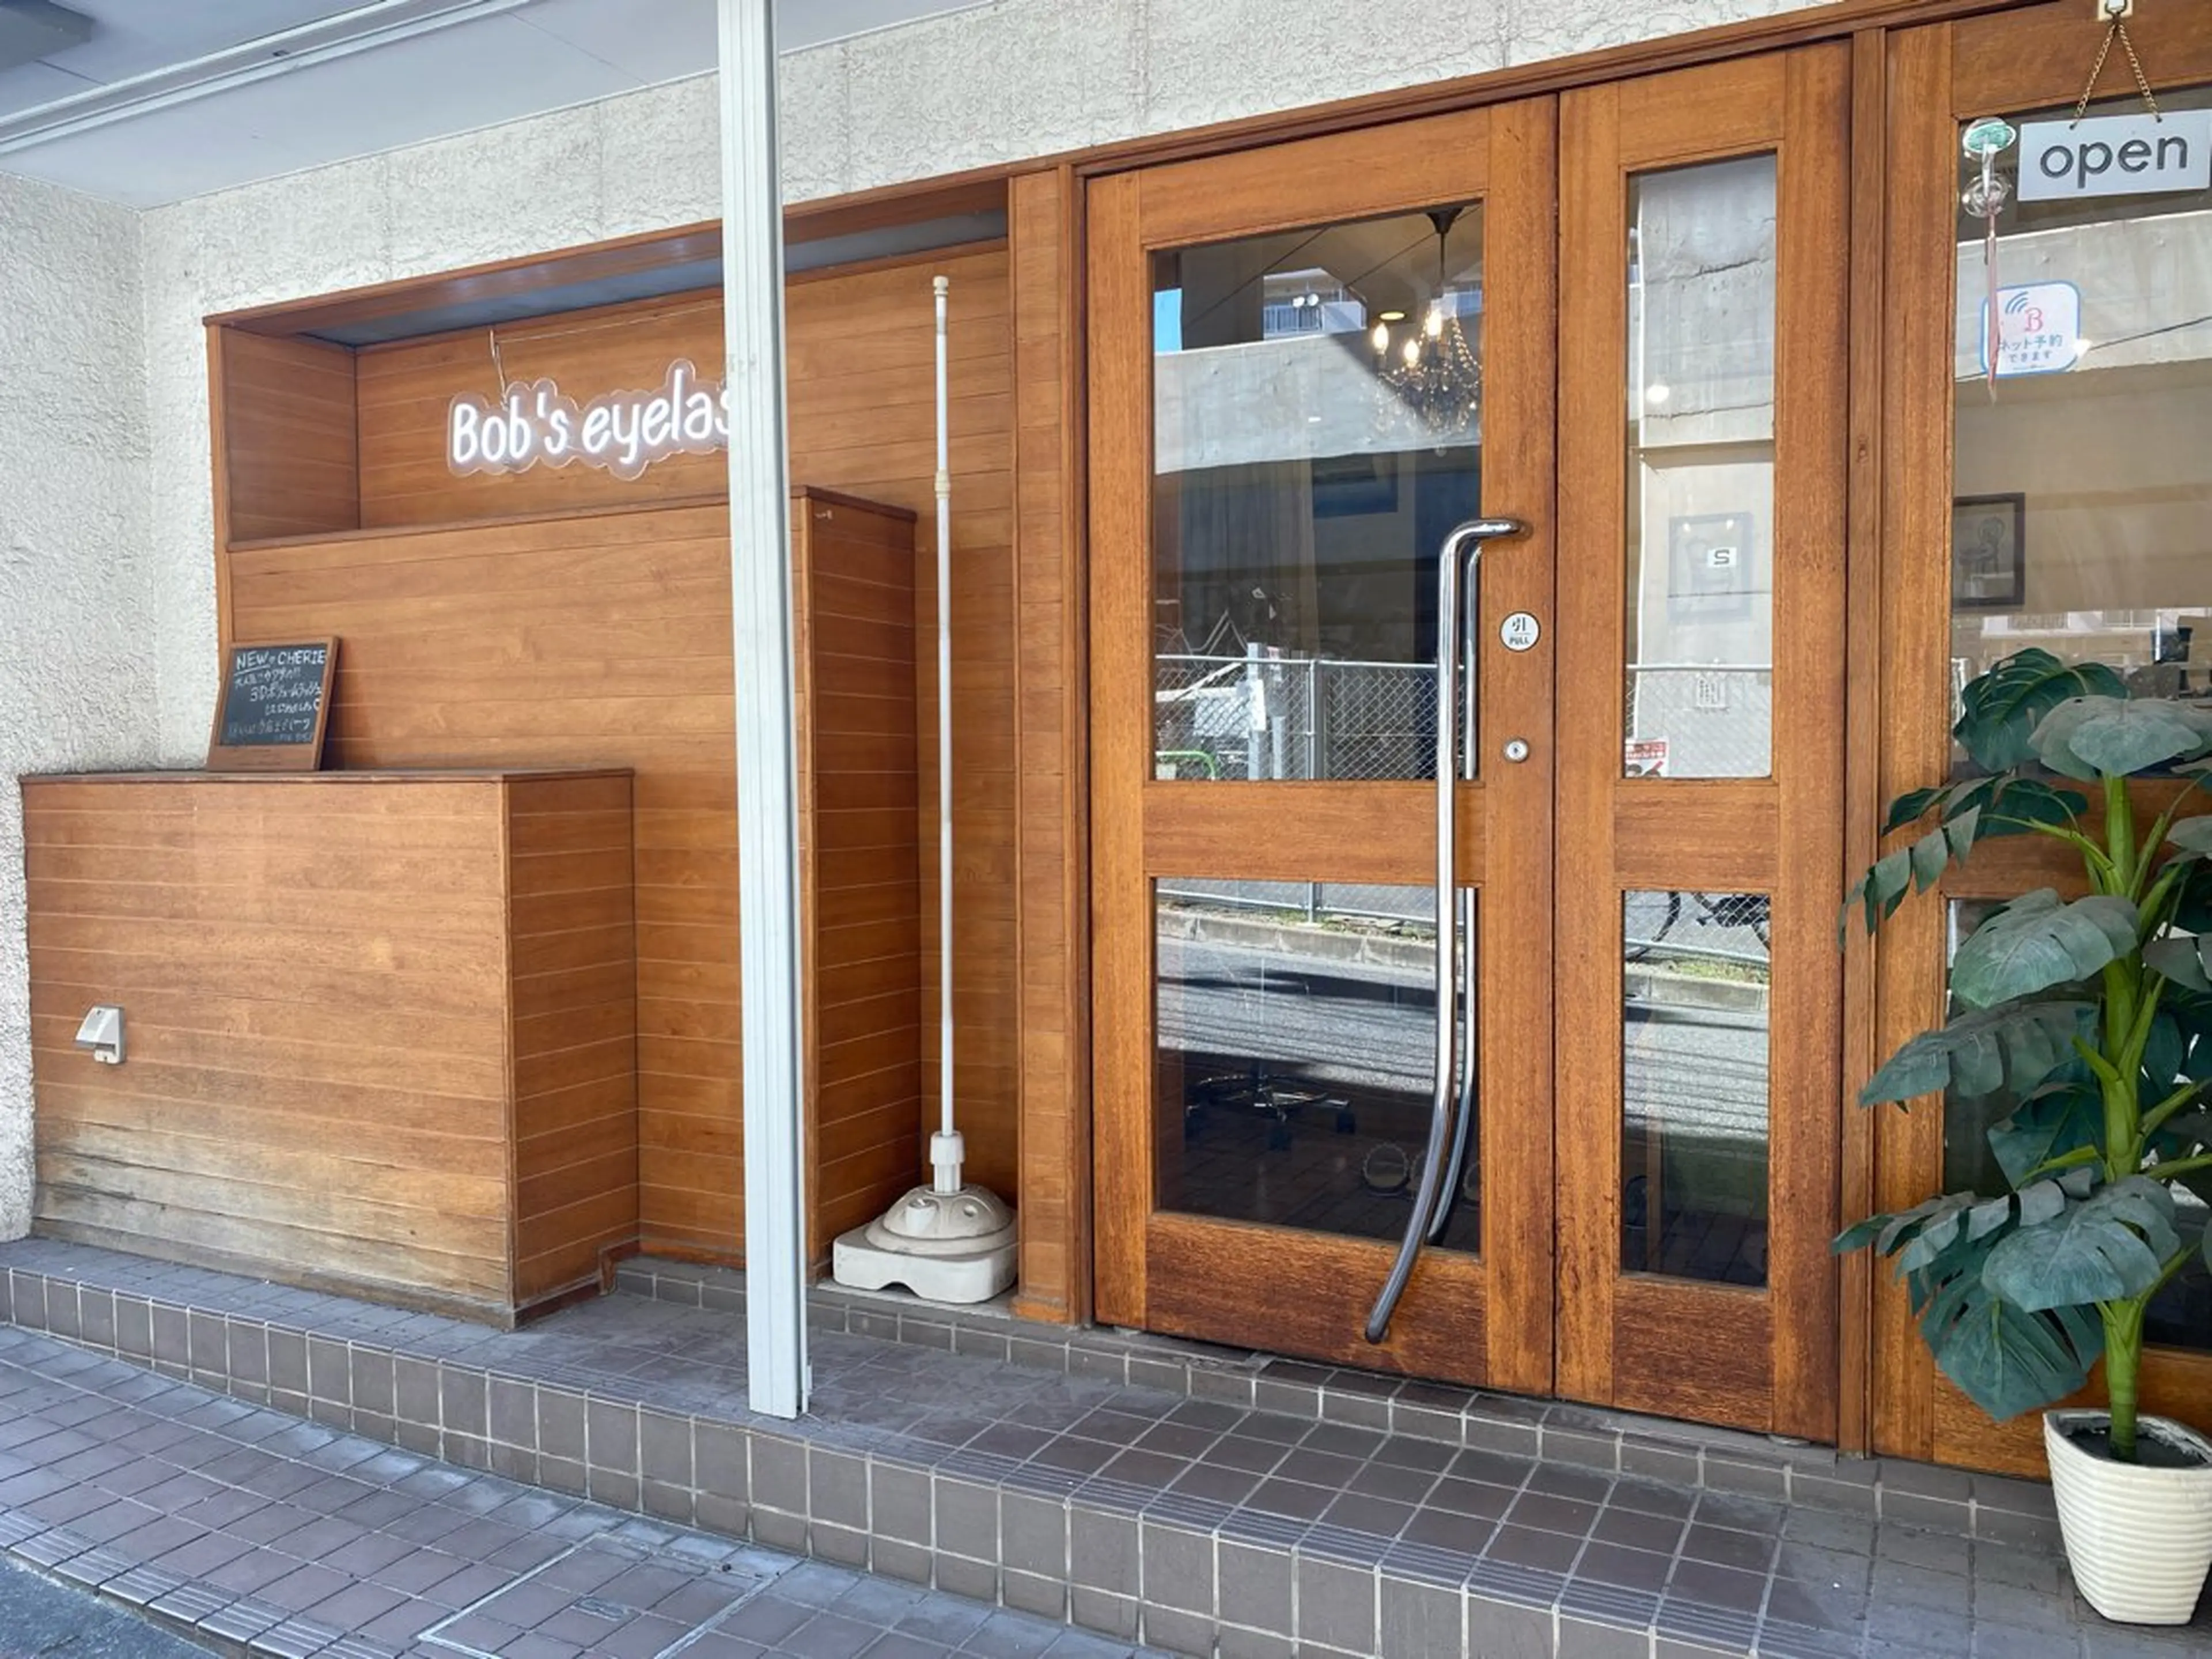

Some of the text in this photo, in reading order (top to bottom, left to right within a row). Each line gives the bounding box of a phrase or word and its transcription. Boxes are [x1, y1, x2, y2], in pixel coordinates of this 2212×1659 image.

[2040, 135, 2188, 189] open
[2024, 306, 2044, 332] B
[453, 368, 730, 464] Bob's eyelas
[1509, 636, 1529, 645] PULL
[236, 650, 270, 671] NEW
